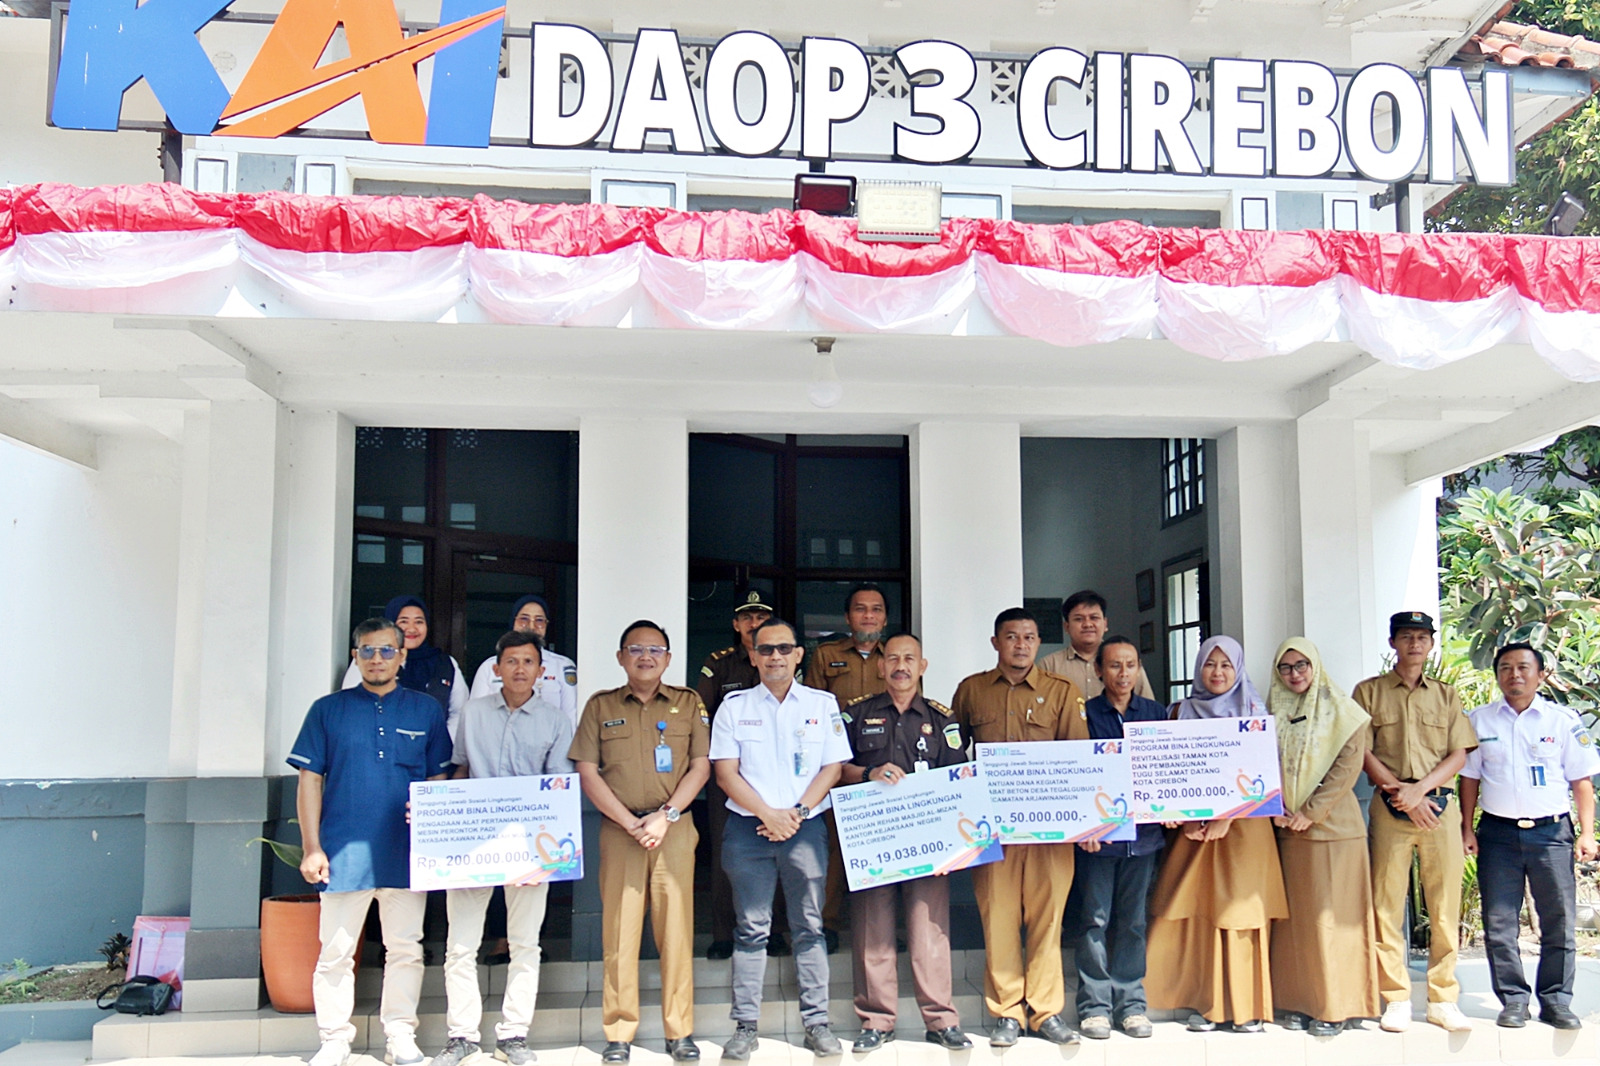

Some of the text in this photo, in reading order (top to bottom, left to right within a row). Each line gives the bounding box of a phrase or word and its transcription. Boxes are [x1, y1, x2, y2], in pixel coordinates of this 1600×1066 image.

[50, 0, 1514, 187] KAI DAOP 3 CIREBON
[1049, 767, 1104, 775] LINGKUNGAN
[1149, 761, 1206, 769] PEMBANGUNAN
[840, 804, 866, 812] Tanggung
[904, 790, 935, 800] Lingkungan
[1134, 790, 1153, 801] Rp.
[1158, 786, 1234, 799] 200.000.000,-
[417, 808, 464, 816] PROGRAM
[490, 804, 549, 813] LINGKUNGAN
[842, 793, 962, 823] PROGRAM BINA LINGKUNGAN
[1010, 810, 1087, 823] 50.000.000,-
[844, 805, 957, 832] BANTUAN REHAB MASJID AL-MIZAN
[845, 817, 941, 840] KANTOR KEJAKSAAN NEGERI
[847, 834, 896, 848] KOTA CIREBON
[418, 857, 440, 869] Rp.
[446, 851, 539, 867] 200.000.000,-
[850, 841, 952, 870] Rp. 19.038.000,-
